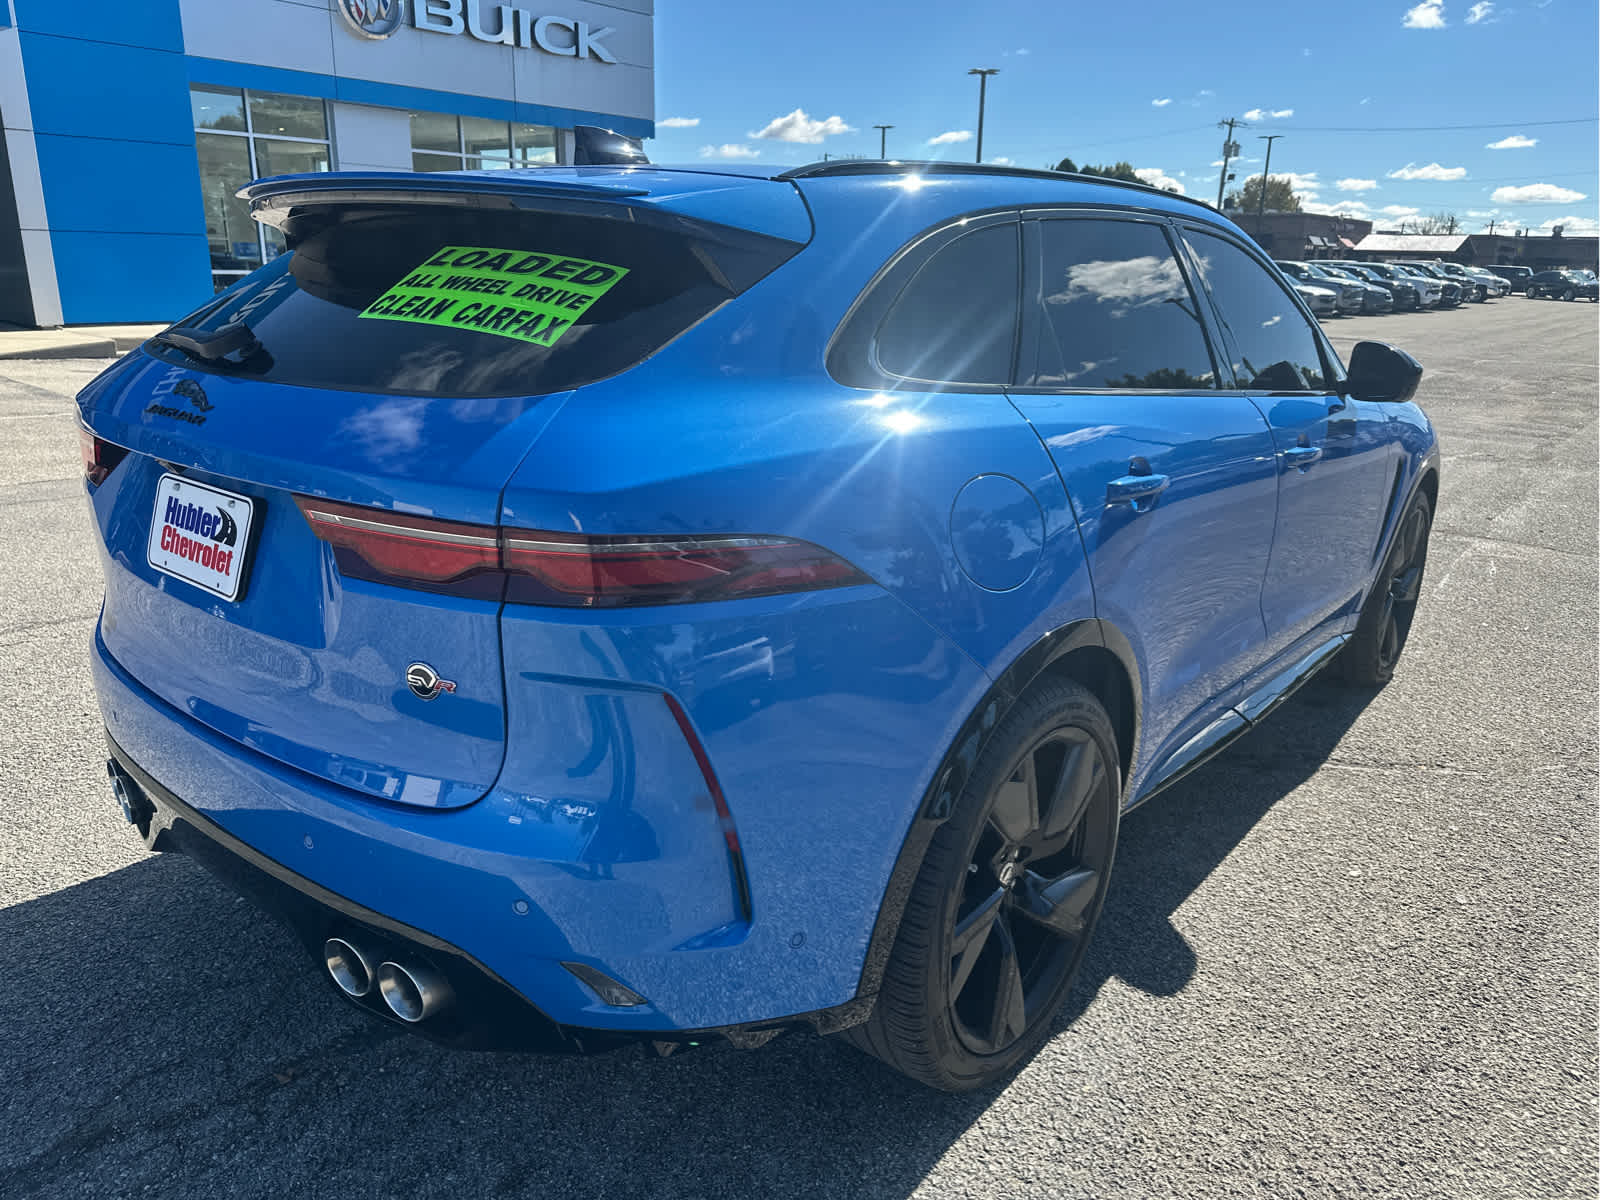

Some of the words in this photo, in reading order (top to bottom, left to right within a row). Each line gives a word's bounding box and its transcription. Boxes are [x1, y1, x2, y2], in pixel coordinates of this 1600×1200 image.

[413, 0, 616, 64] BUICK
[424, 249, 619, 286] LOADED
[398, 273, 442, 289] ALL
[439, 275, 514, 296] WHEEL
[512, 283, 594, 312] DRIVE
[367, 294, 458, 321] CLEAN
[451, 302, 570, 342] CARFAX
[165, 496, 220, 540] Hubler
[161, 525, 233, 576] Chevrolet
